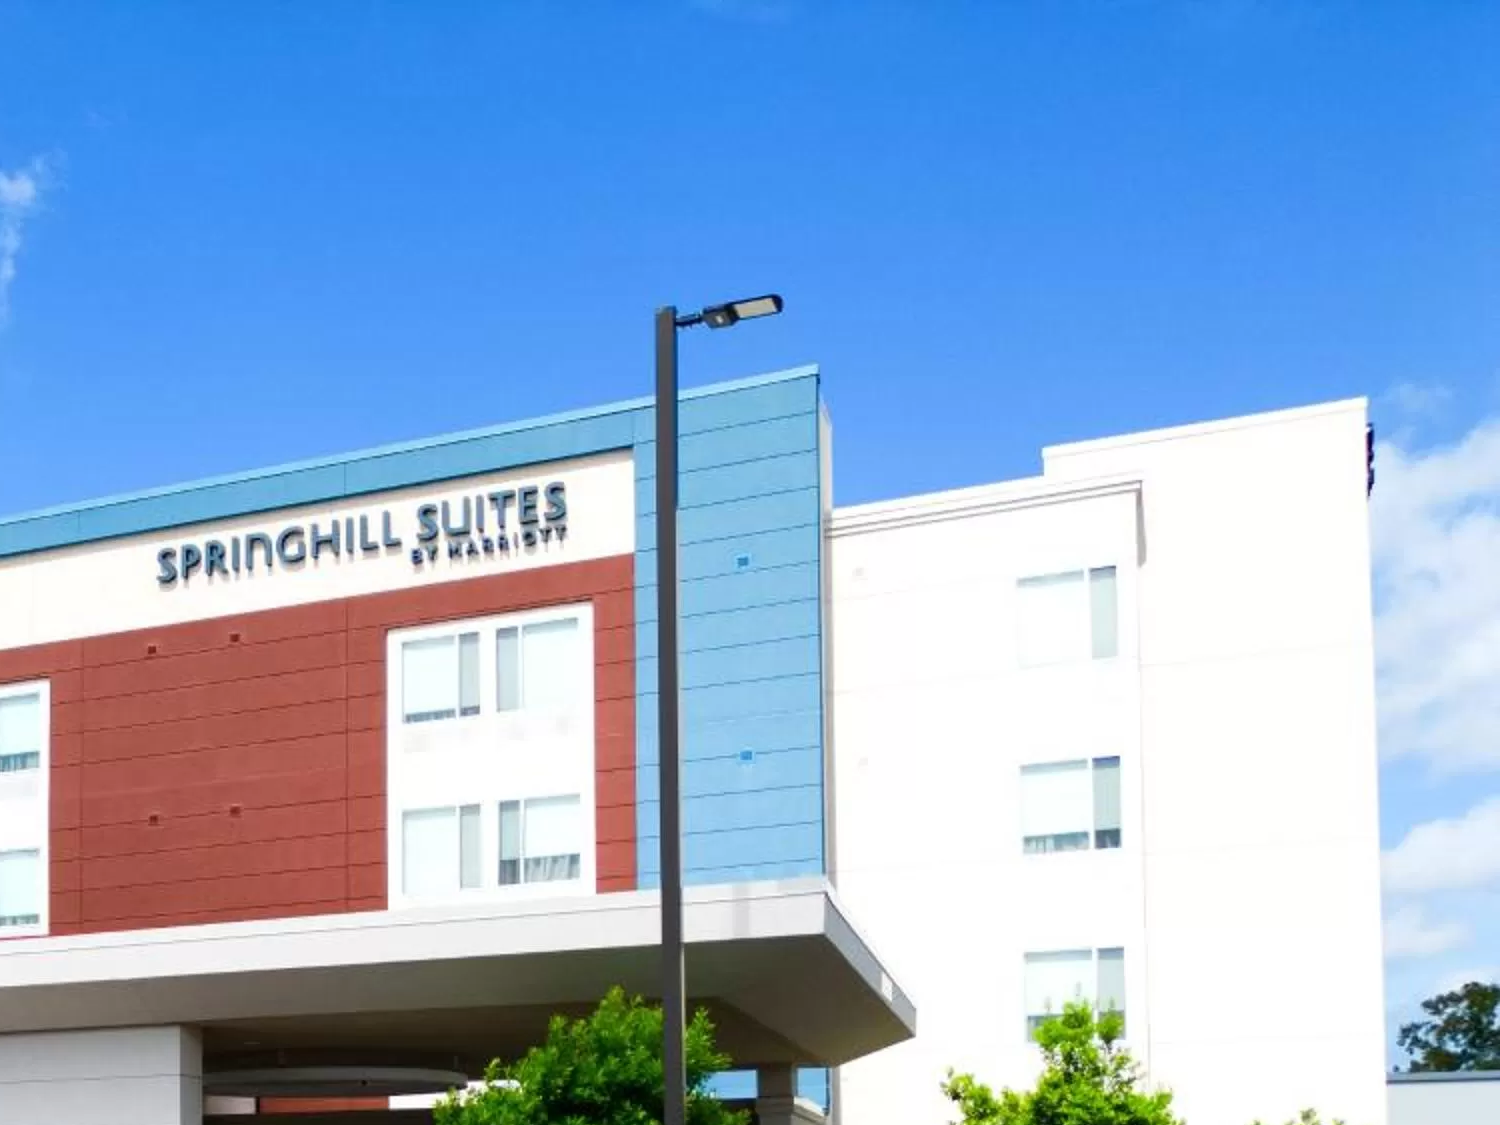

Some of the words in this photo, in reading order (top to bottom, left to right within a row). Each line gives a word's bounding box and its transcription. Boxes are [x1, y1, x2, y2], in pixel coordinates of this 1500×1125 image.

[156, 509, 403, 584] SPRINGHILL
[416, 481, 567, 541] SUITES
[410, 544, 439, 566] BY
[447, 524, 567, 561] MARRIOTT
